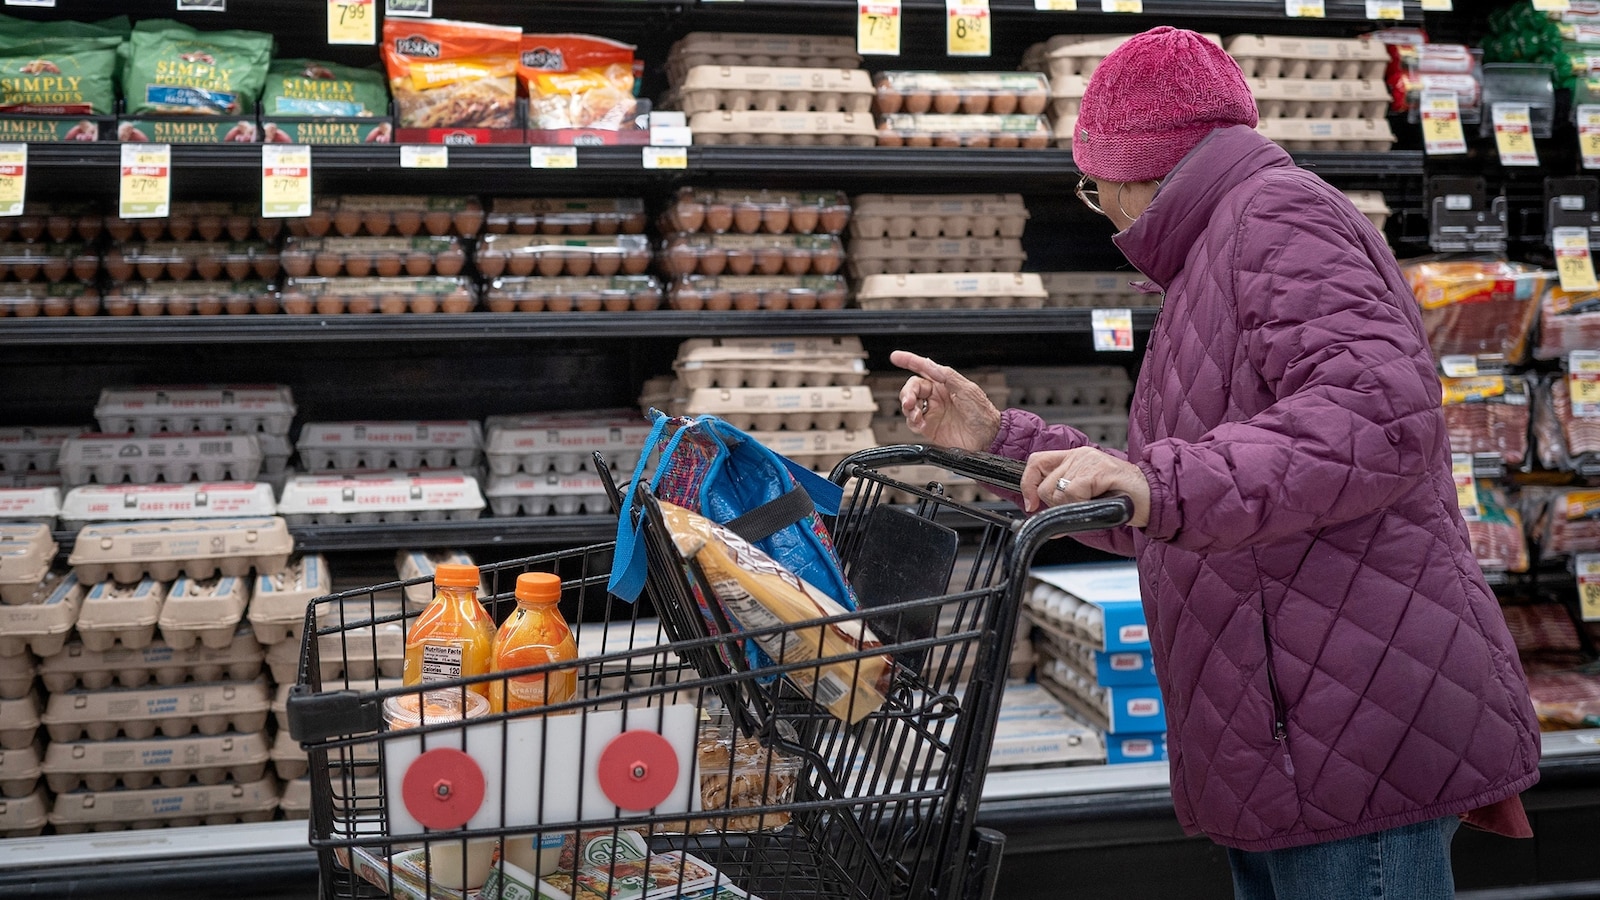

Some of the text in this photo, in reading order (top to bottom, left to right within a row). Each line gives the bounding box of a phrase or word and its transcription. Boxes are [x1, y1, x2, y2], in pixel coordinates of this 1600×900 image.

[337, 4, 365, 25] 799
[157, 60, 233, 82] SIMPLY
[1, 76, 82, 93] SIMPLY
[156, 74, 230, 92] POTATOES
[283, 79, 355, 92] SIMPLY
[5, 92, 83, 104] POTATOES
[0, 120, 58, 133] IMPLY
[154, 122, 218, 135] SIMPLY
[297, 123, 360, 136] SIMPLY
[0, 133, 59, 142] OTATOES
[155, 135, 218, 143] POTATOES
[298, 136, 361, 144] POTATOES
